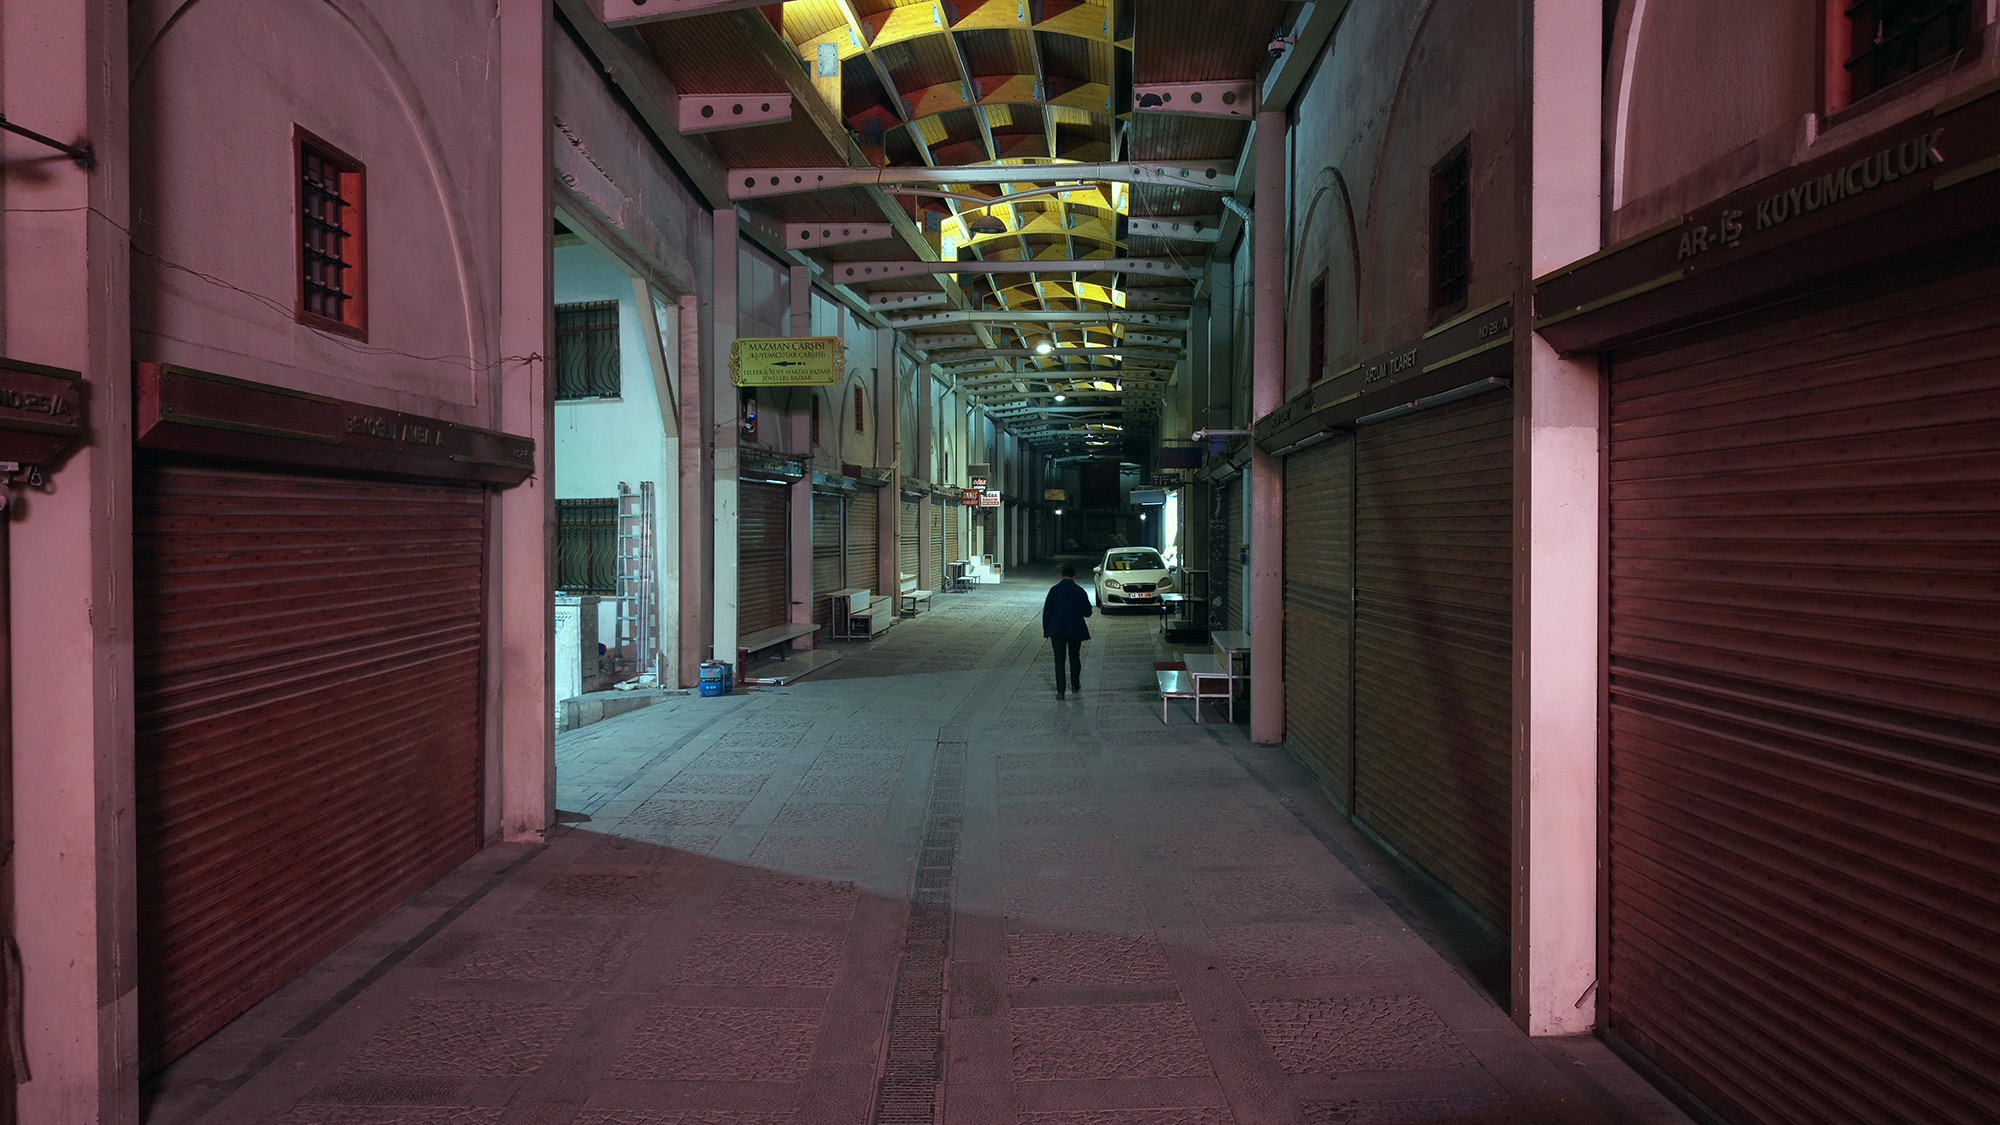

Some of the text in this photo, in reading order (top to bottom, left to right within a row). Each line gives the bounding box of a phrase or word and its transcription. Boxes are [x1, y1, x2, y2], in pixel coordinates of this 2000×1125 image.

[1677, 128, 1945, 261] AR-İŞ KUYUMCULUK
[749, 342, 825, 351] MAZMAN ÇARŞISI
